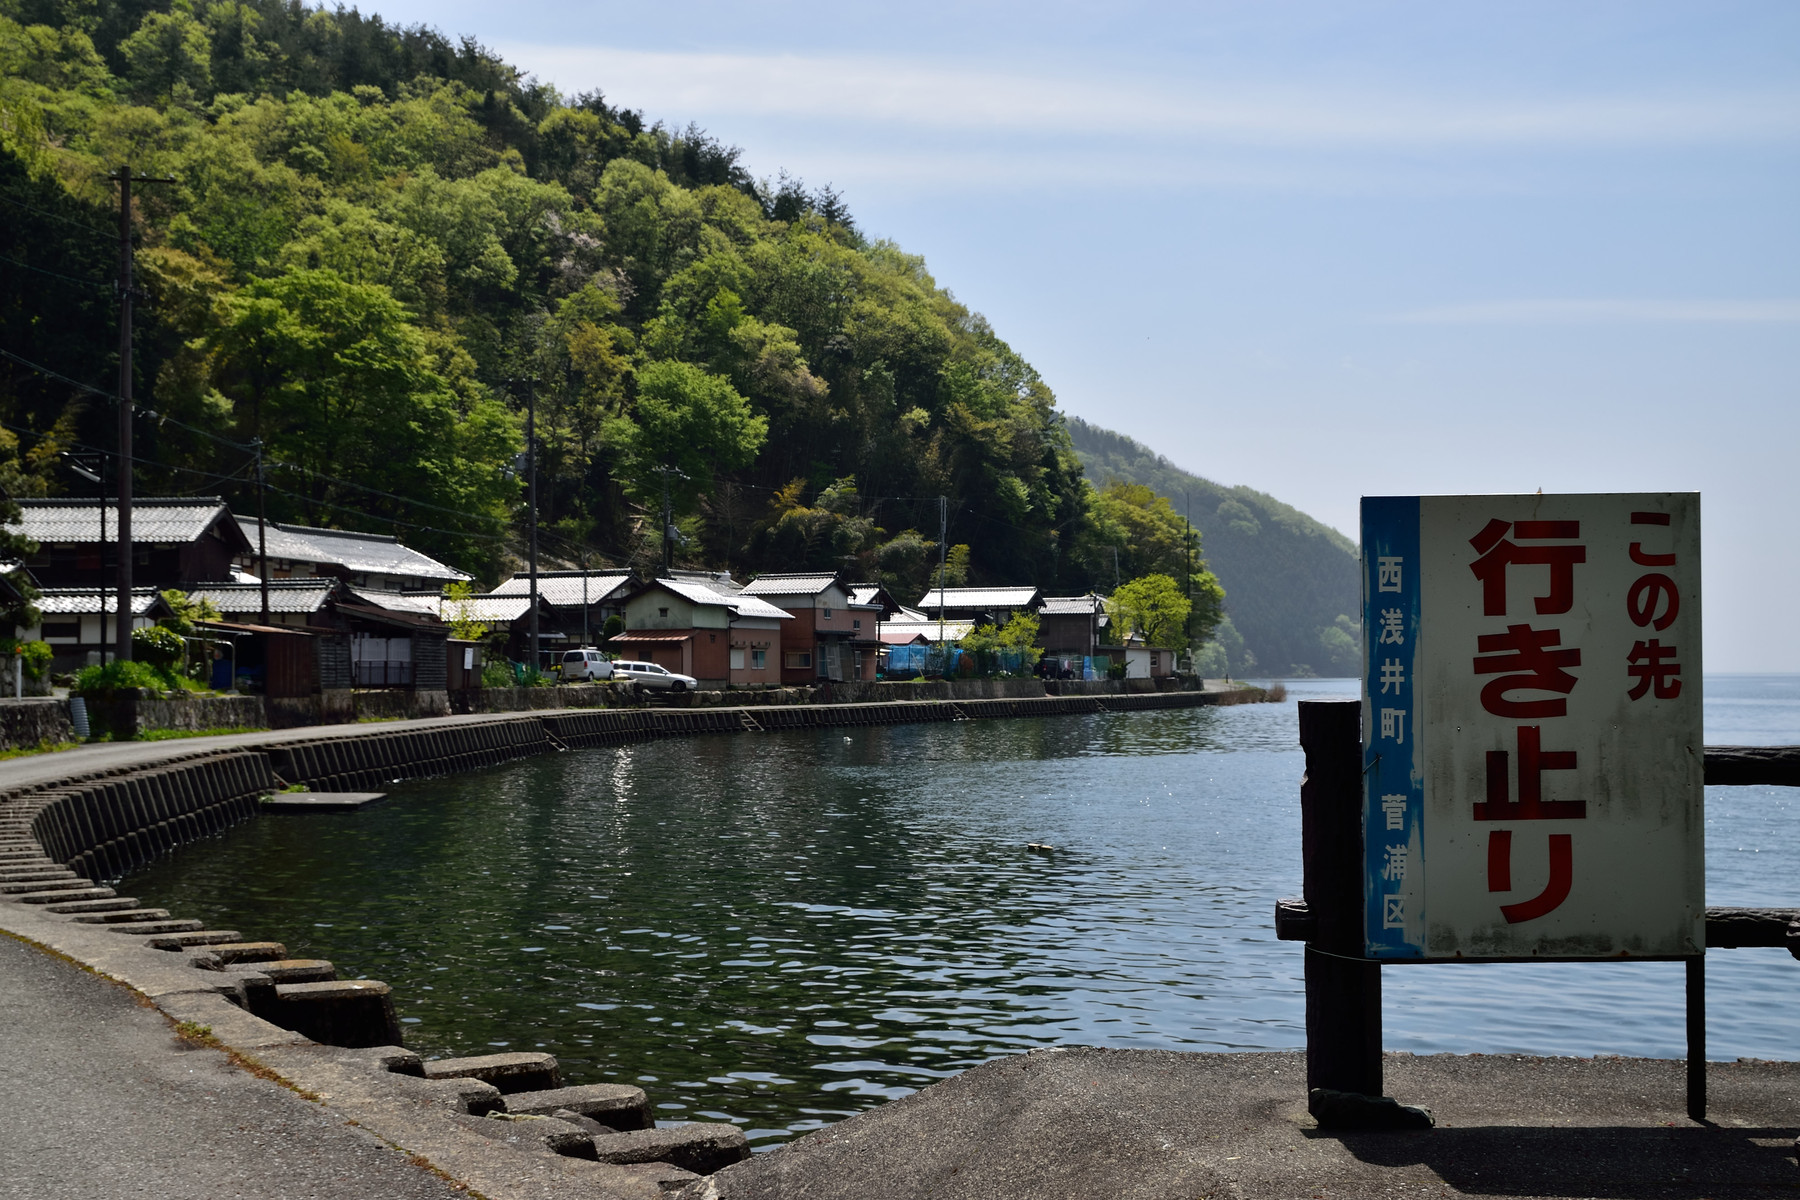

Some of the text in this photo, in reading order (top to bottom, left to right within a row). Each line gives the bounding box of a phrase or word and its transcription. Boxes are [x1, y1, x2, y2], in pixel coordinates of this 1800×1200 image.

[1378, 556, 1408, 930] 西浅井町 菅浦区
[1468, 518, 1586, 924] 行き止り
[1626, 511, 1682, 701] この先
